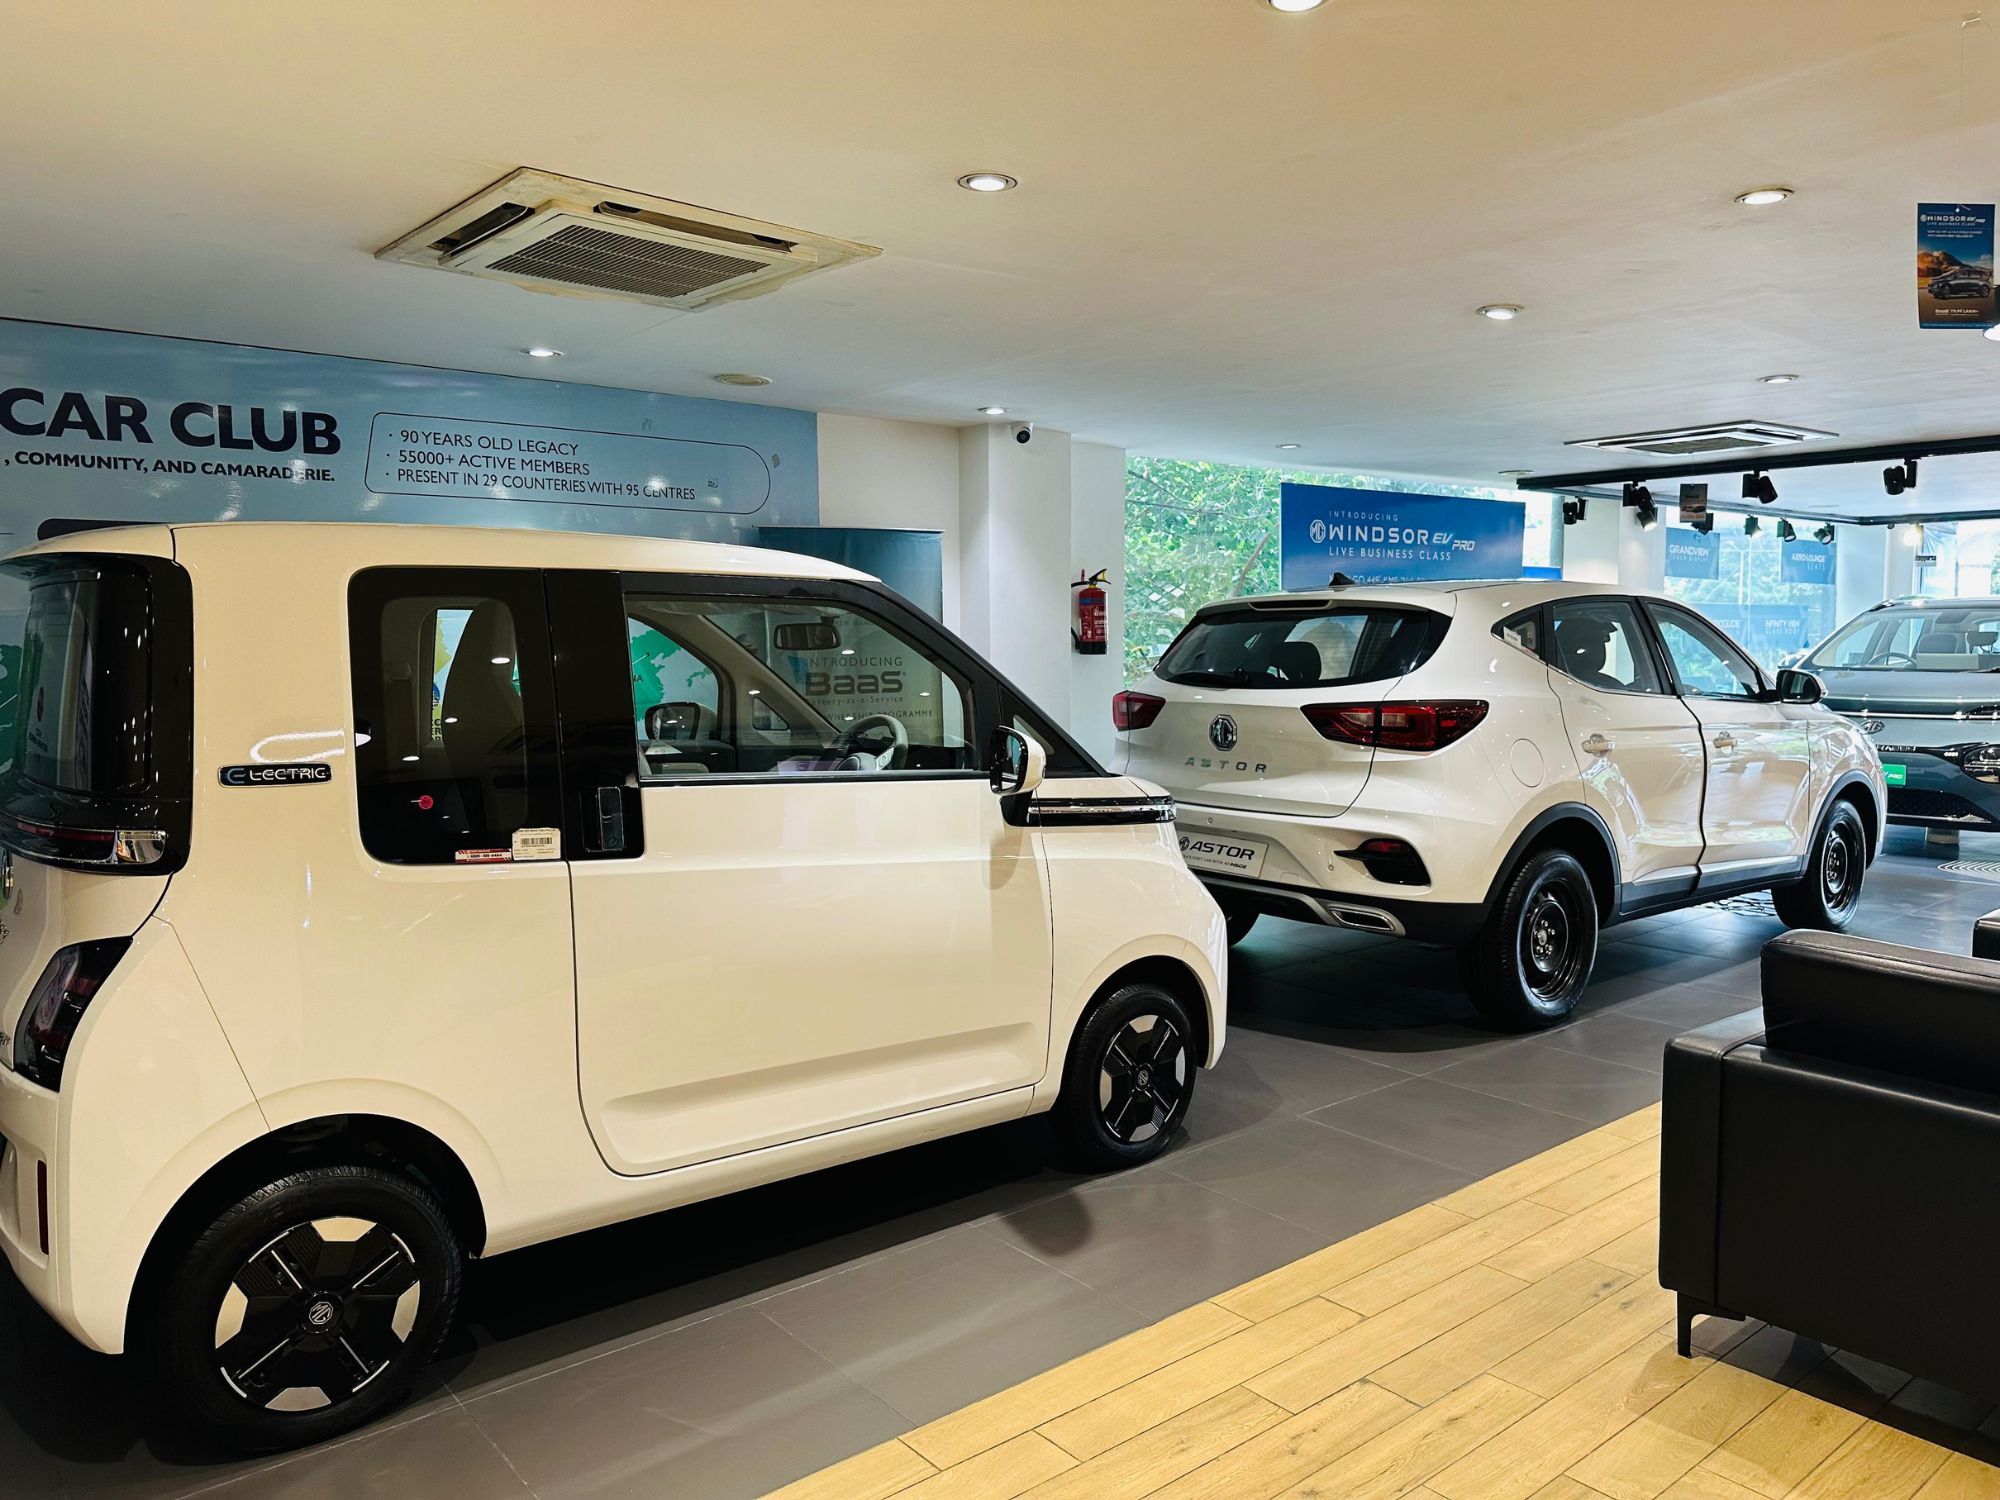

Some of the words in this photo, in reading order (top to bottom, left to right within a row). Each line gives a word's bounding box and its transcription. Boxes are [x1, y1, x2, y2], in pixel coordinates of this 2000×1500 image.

[0, 387, 153, 444] CAR
[169, 401, 341, 455] CLUB
[400, 429, 420, 444] 90
[421, 431, 473, 449] YEARS
[477, 434, 513, 451] OLD
[517, 438, 579, 456] LEGACY
[14, 450, 149, 474] COMMUNITY,
[152, 458, 197, 475] AND
[397, 450, 455, 466] 55000+
[458, 454, 518, 471] ACTIVE
[520, 458, 590, 476] MEMBERS
[397, 468, 458, 485] PRESENT
[463, 472, 478, 486] IN
[482, 474, 498, 488] 29
[501, 475, 586, 493] COUNTERIES
[587, 480, 623, 496] WITH
[626, 483, 640, 497] 95
[643, 485, 696, 500] CENTRES
[1329, 510, 1399, 522] INTRODUCING
[1329, 524, 1429, 545] WINDSOR
[1432, 532, 1454, 544] EV
[1452, 540, 1476, 551] PRO
[1329, 546, 1354, 557] LIVE
[1360, 548, 1413, 559] BUSINESS
[1419, 550, 1451, 561] CLASS
[809, 657, 904, 668] INTRODUCING
[806, 671, 904, 697] BaaS
[226, 767, 327, 784] ELECTRIC
[1184, 757, 1268, 774] ASTOR
[1190, 841, 1255, 860] ASTOR
